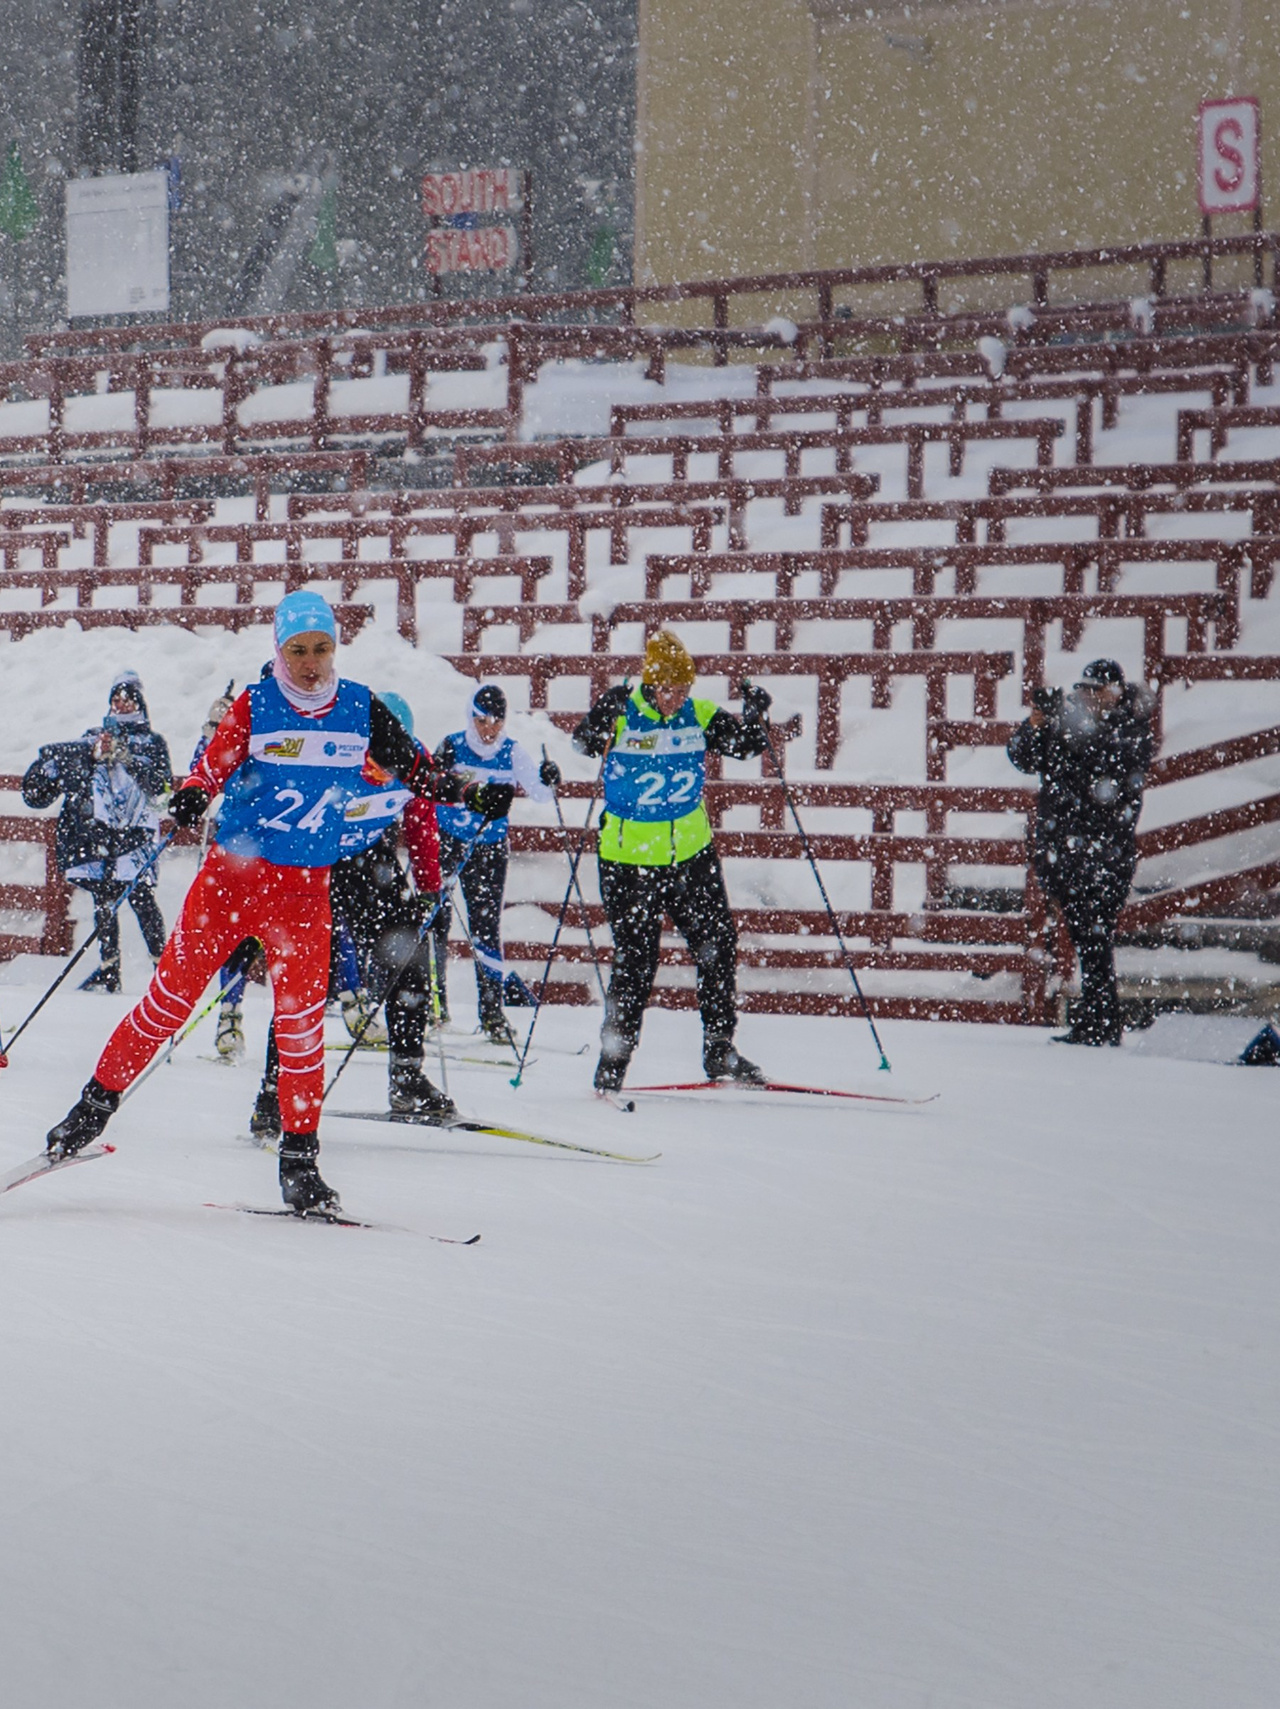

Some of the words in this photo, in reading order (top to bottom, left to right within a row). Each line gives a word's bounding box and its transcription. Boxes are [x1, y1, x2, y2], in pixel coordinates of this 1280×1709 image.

[1213, 118, 1245, 193] S
[421, 168, 508, 216] SOUTH
[425, 227, 508, 274] STAND
[263, 788, 332, 834] 24
[637, 770, 696, 806] 22
